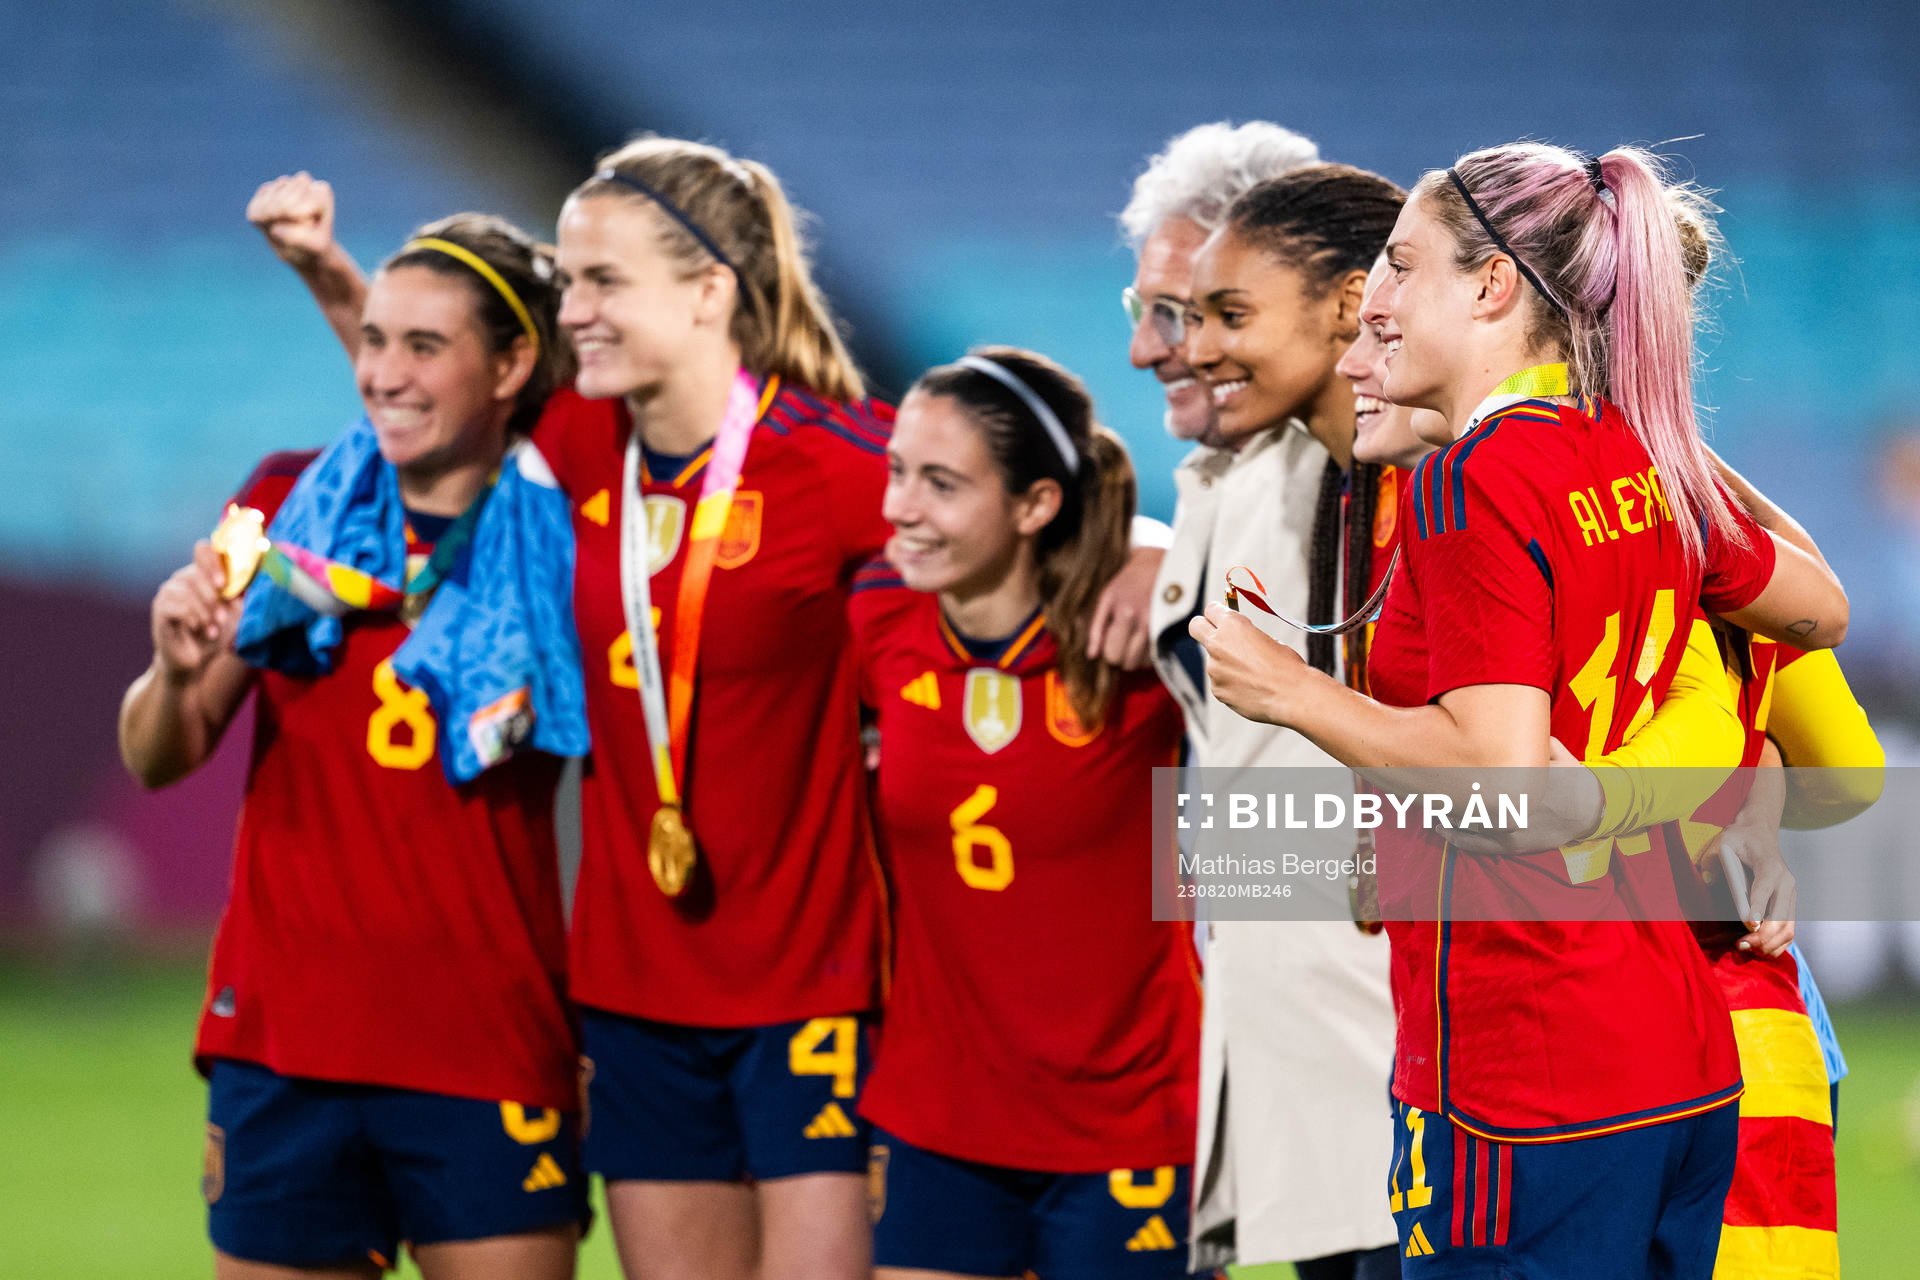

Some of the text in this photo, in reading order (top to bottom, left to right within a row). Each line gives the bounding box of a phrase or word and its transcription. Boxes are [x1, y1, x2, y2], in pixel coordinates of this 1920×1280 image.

[367, 656, 436, 770] 8
[950, 784, 1014, 891] 6
[789, 1016, 859, 1098] 4
